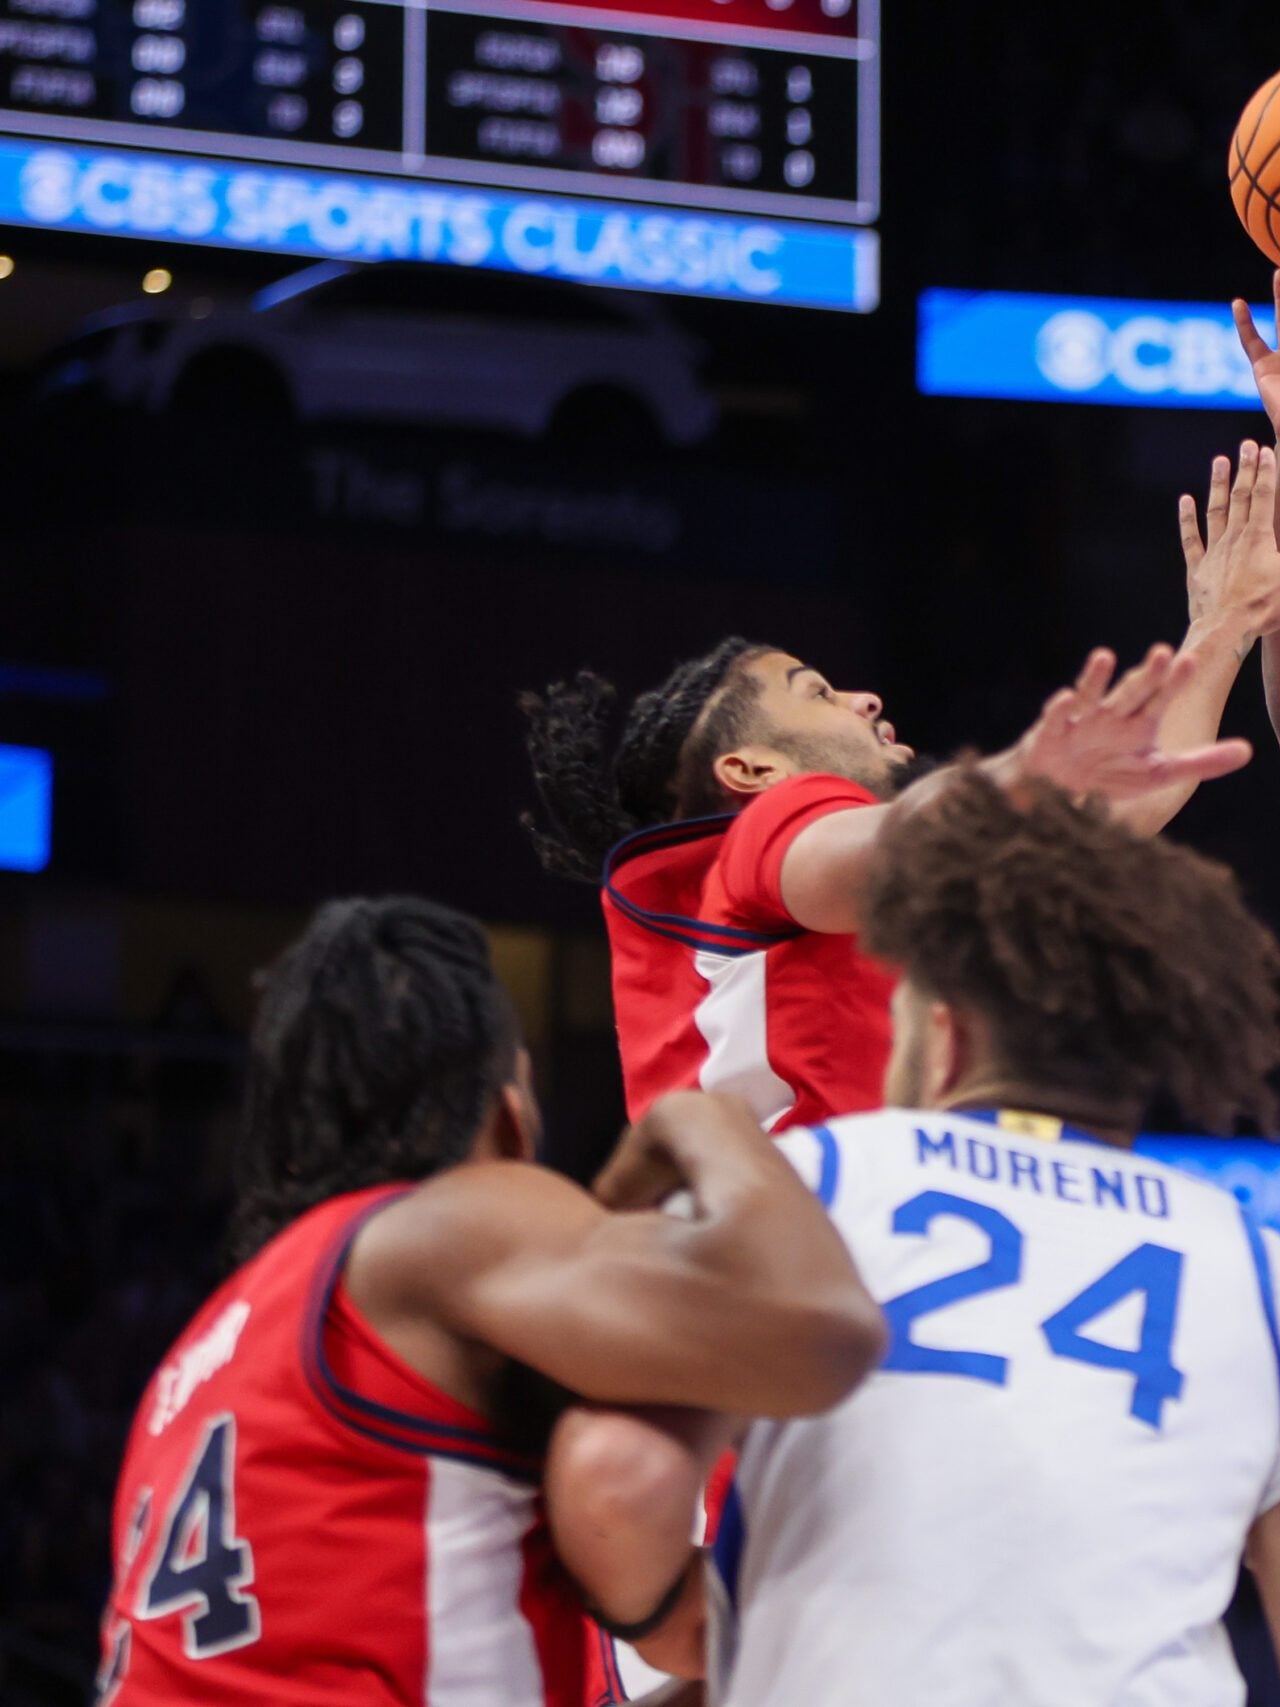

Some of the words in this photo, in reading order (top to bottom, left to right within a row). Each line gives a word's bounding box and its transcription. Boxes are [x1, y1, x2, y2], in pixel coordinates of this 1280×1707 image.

[80, 156, 217, 237] CBS
[225, 170, 494, 266] SPORTS
[502, 202, 784, 296] CLASSIC
[914, 1127, 1172, 1220] MORENO
[880, 1189, 1186, 1436] 24
